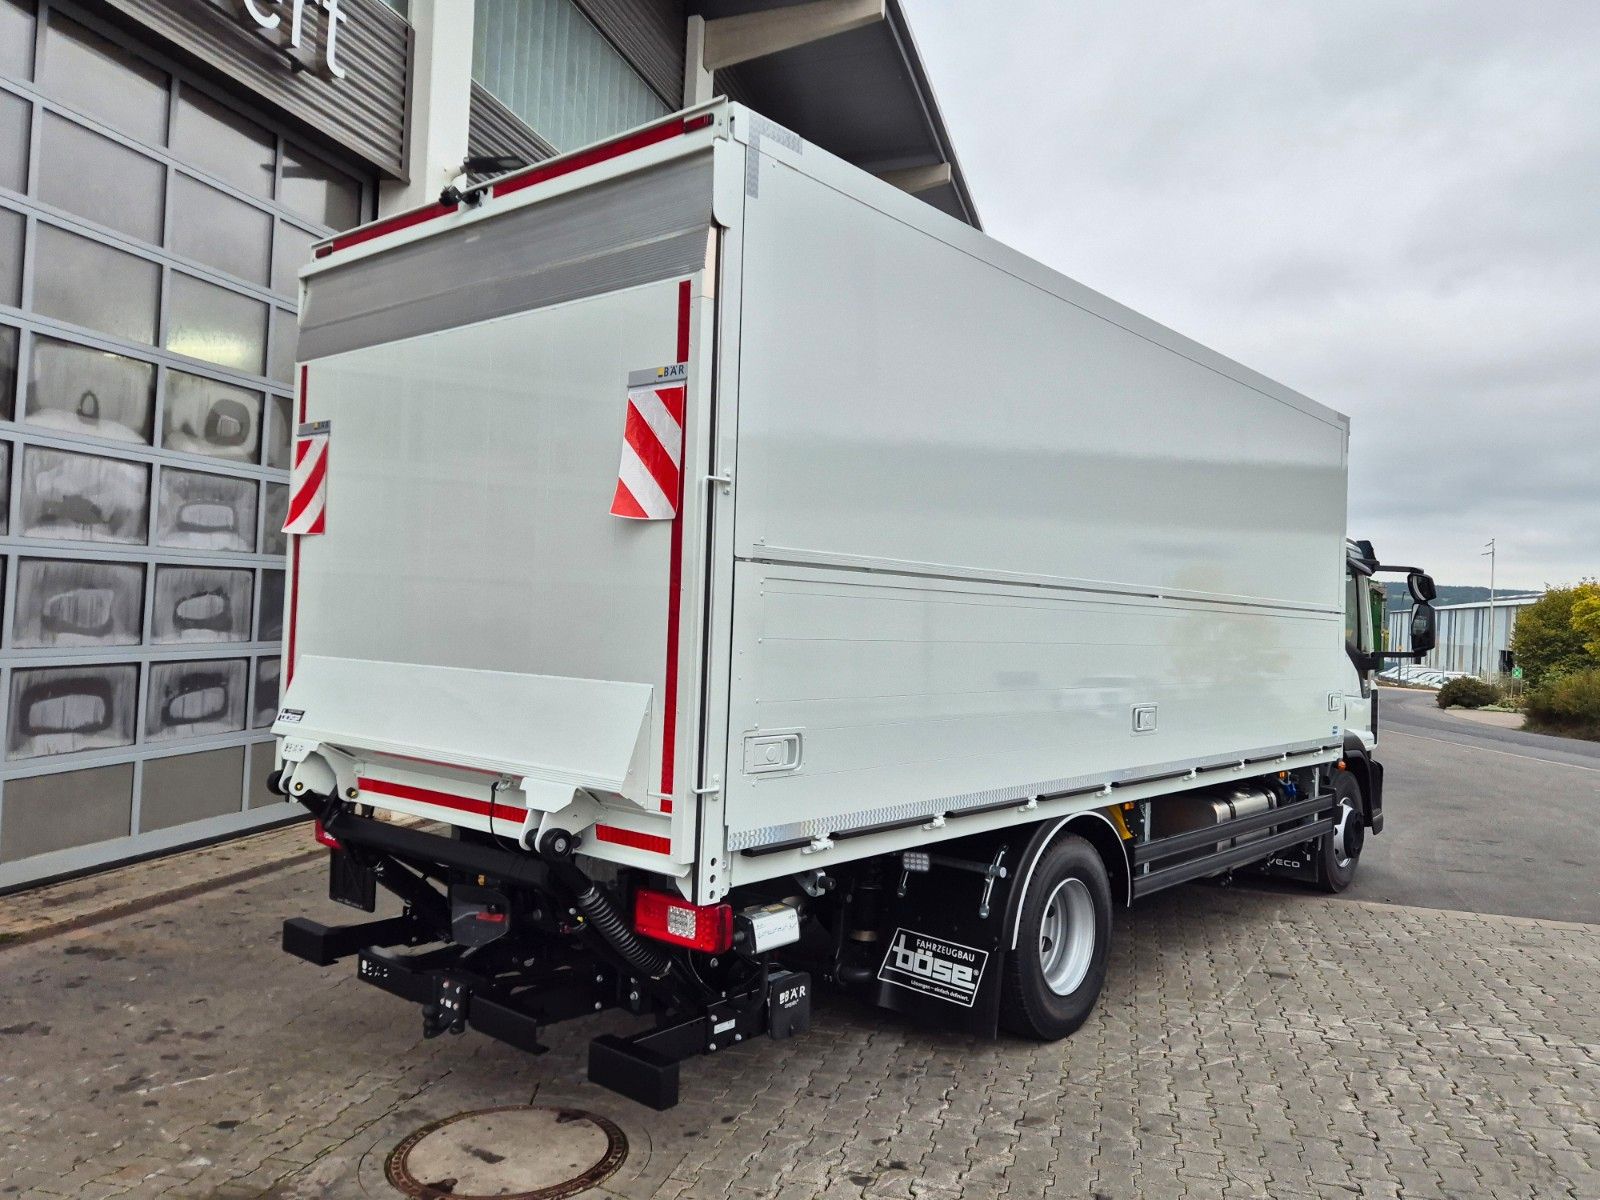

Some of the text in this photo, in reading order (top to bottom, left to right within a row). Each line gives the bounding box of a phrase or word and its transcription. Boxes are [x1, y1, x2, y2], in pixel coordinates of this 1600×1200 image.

[663, 364, 685, 377] BÄR
[916, 938, 975, 962] FAHRZEUGBAU
[784, 985, 806, 1003] BÄR
